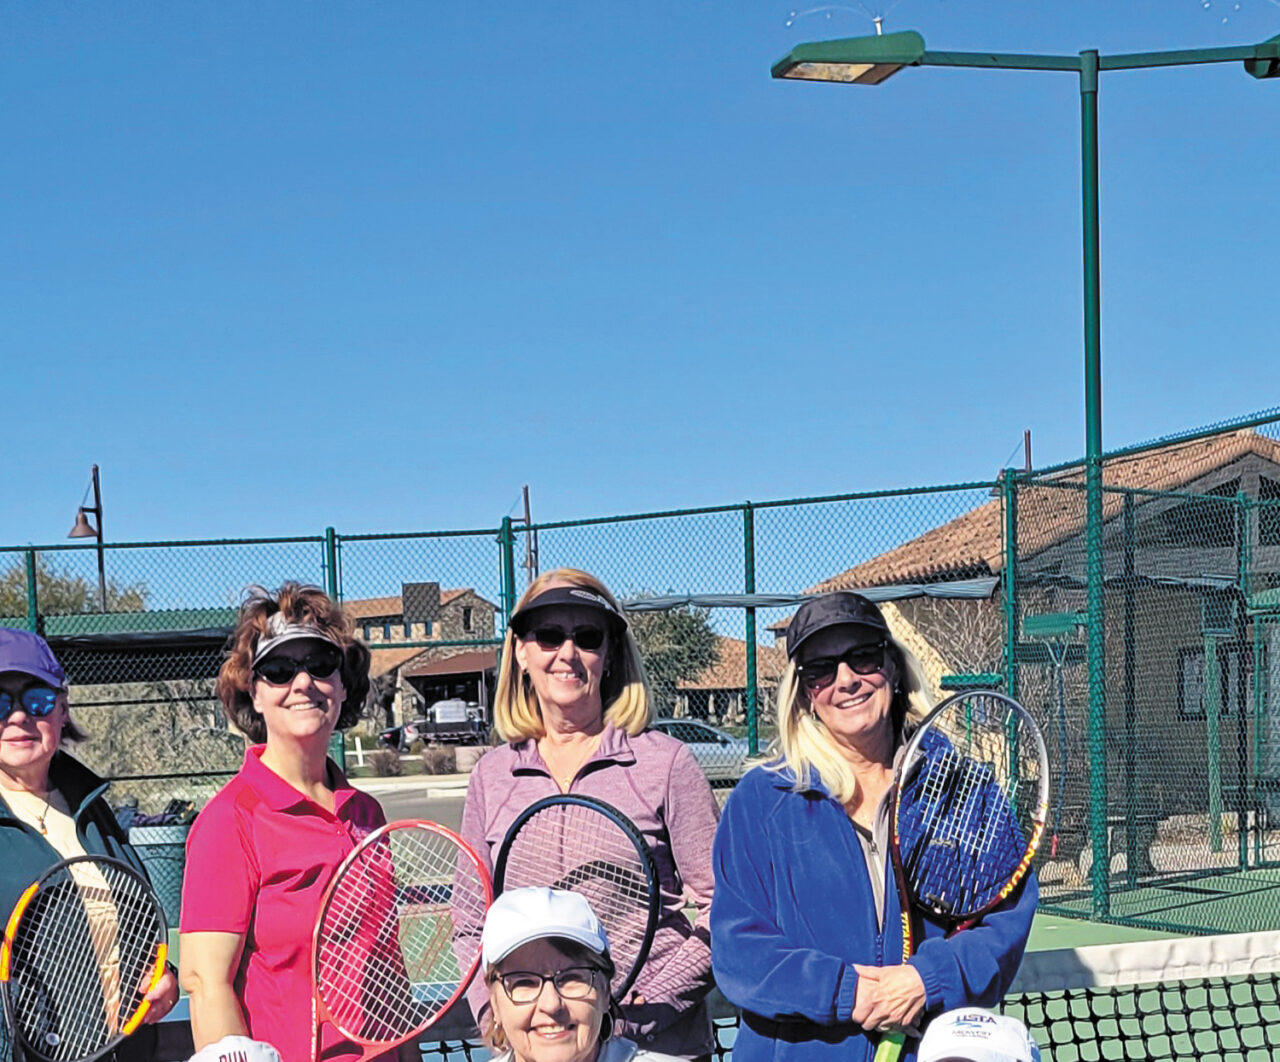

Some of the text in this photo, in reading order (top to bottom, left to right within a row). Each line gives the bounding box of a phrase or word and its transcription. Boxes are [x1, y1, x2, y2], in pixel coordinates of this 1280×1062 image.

[999, 802, 1048, 898] TANIUM
[901, 912, 910, 966] TITANIU
[957, 1014, 997, 1024] USTA
